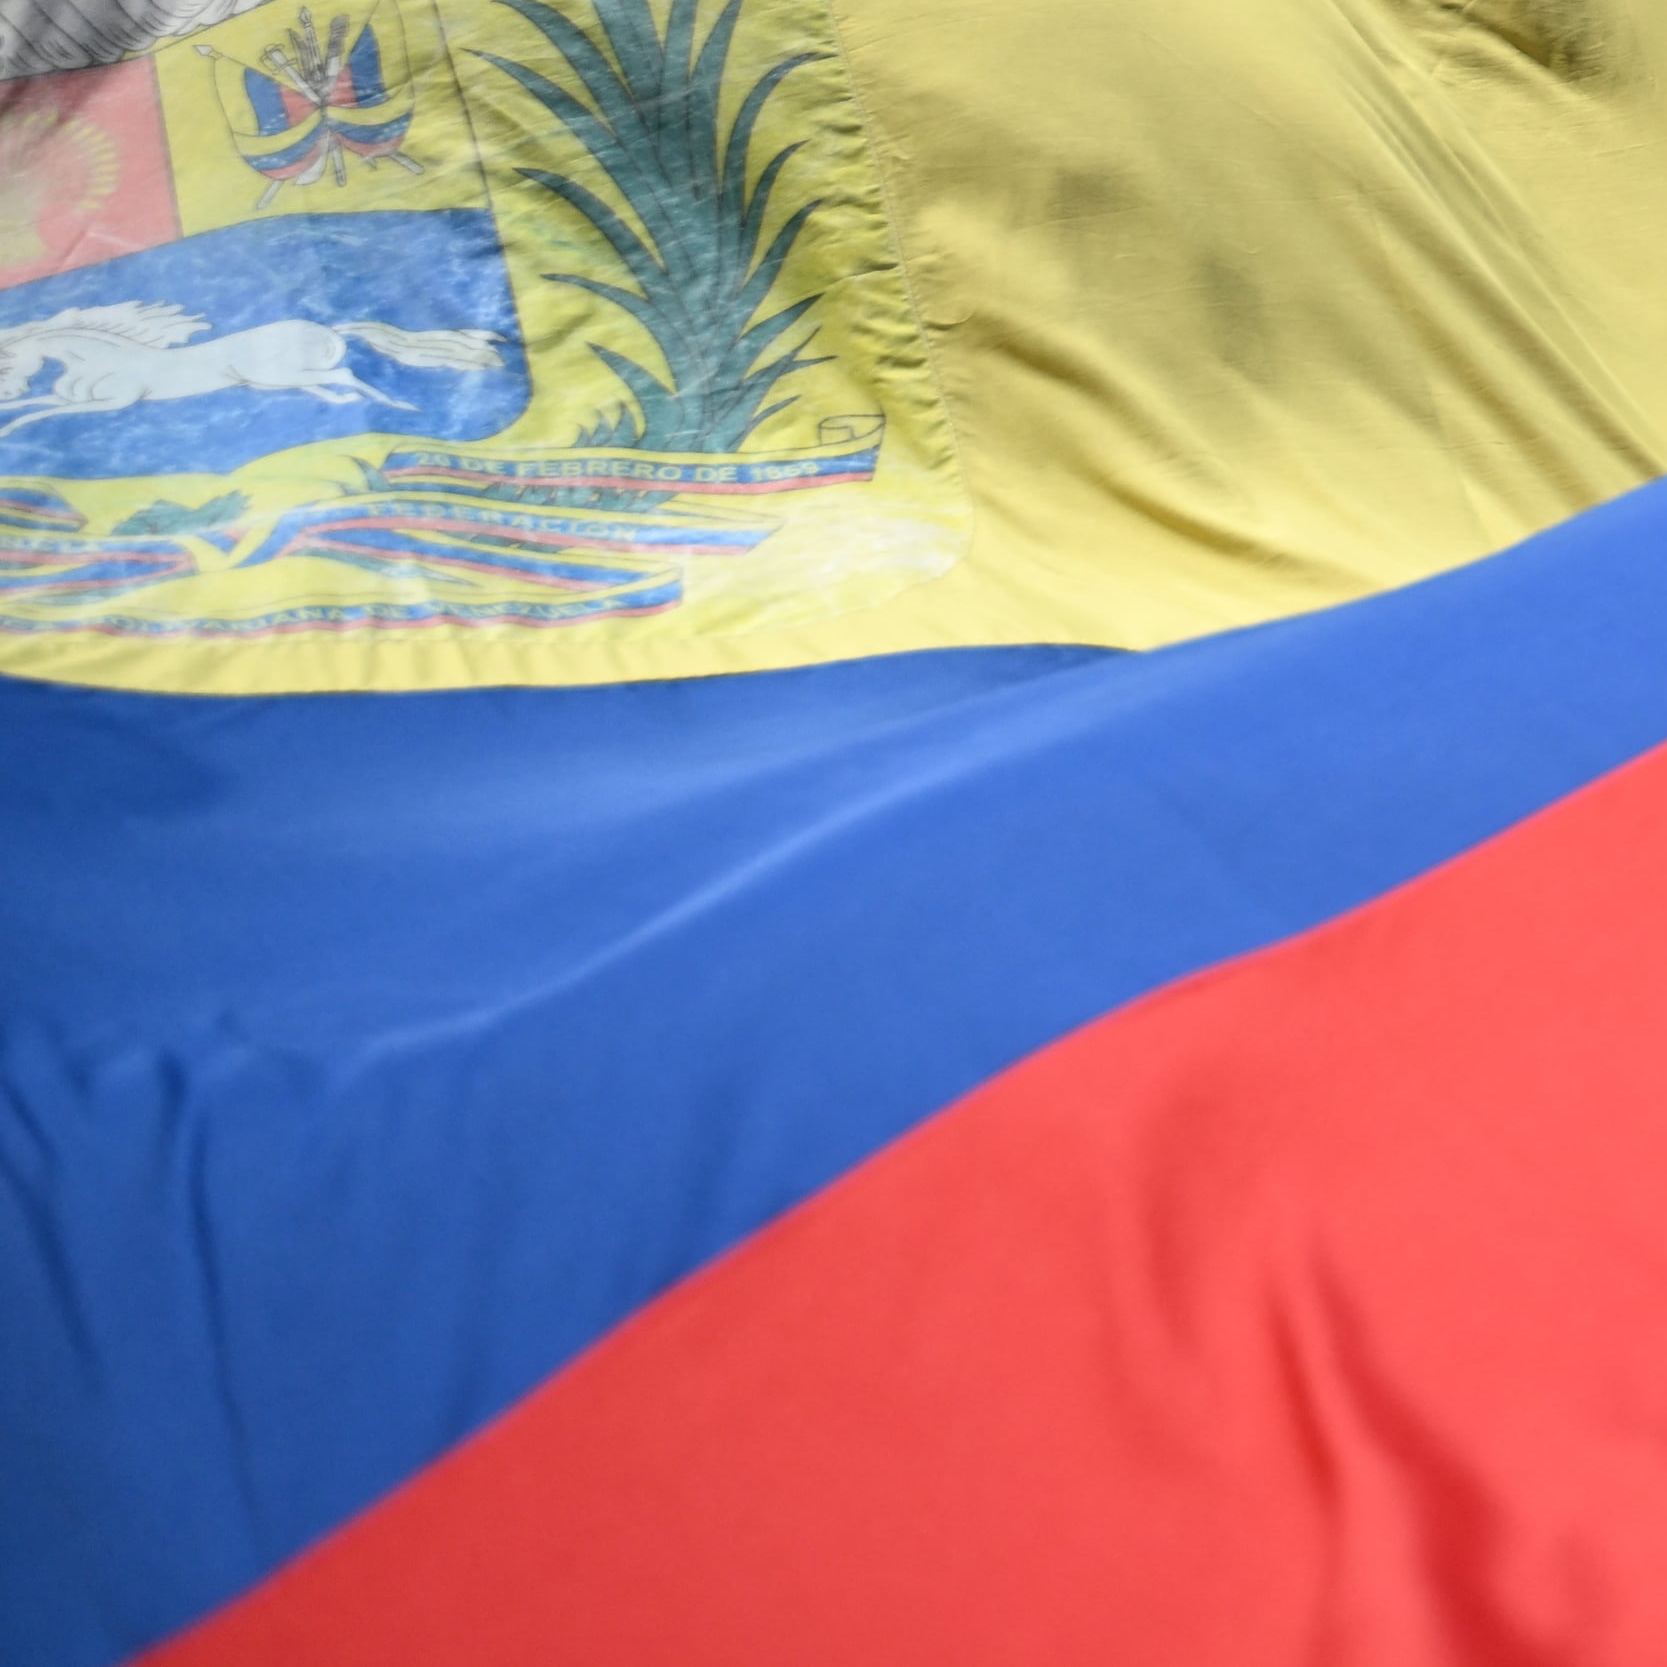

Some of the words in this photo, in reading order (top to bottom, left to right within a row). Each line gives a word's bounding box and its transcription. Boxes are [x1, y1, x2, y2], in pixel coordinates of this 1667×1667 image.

[459, 454, 505, 477] DE
[516, 456, 683, 482] FEBRERO
[694, 463, 739, 483] DE
